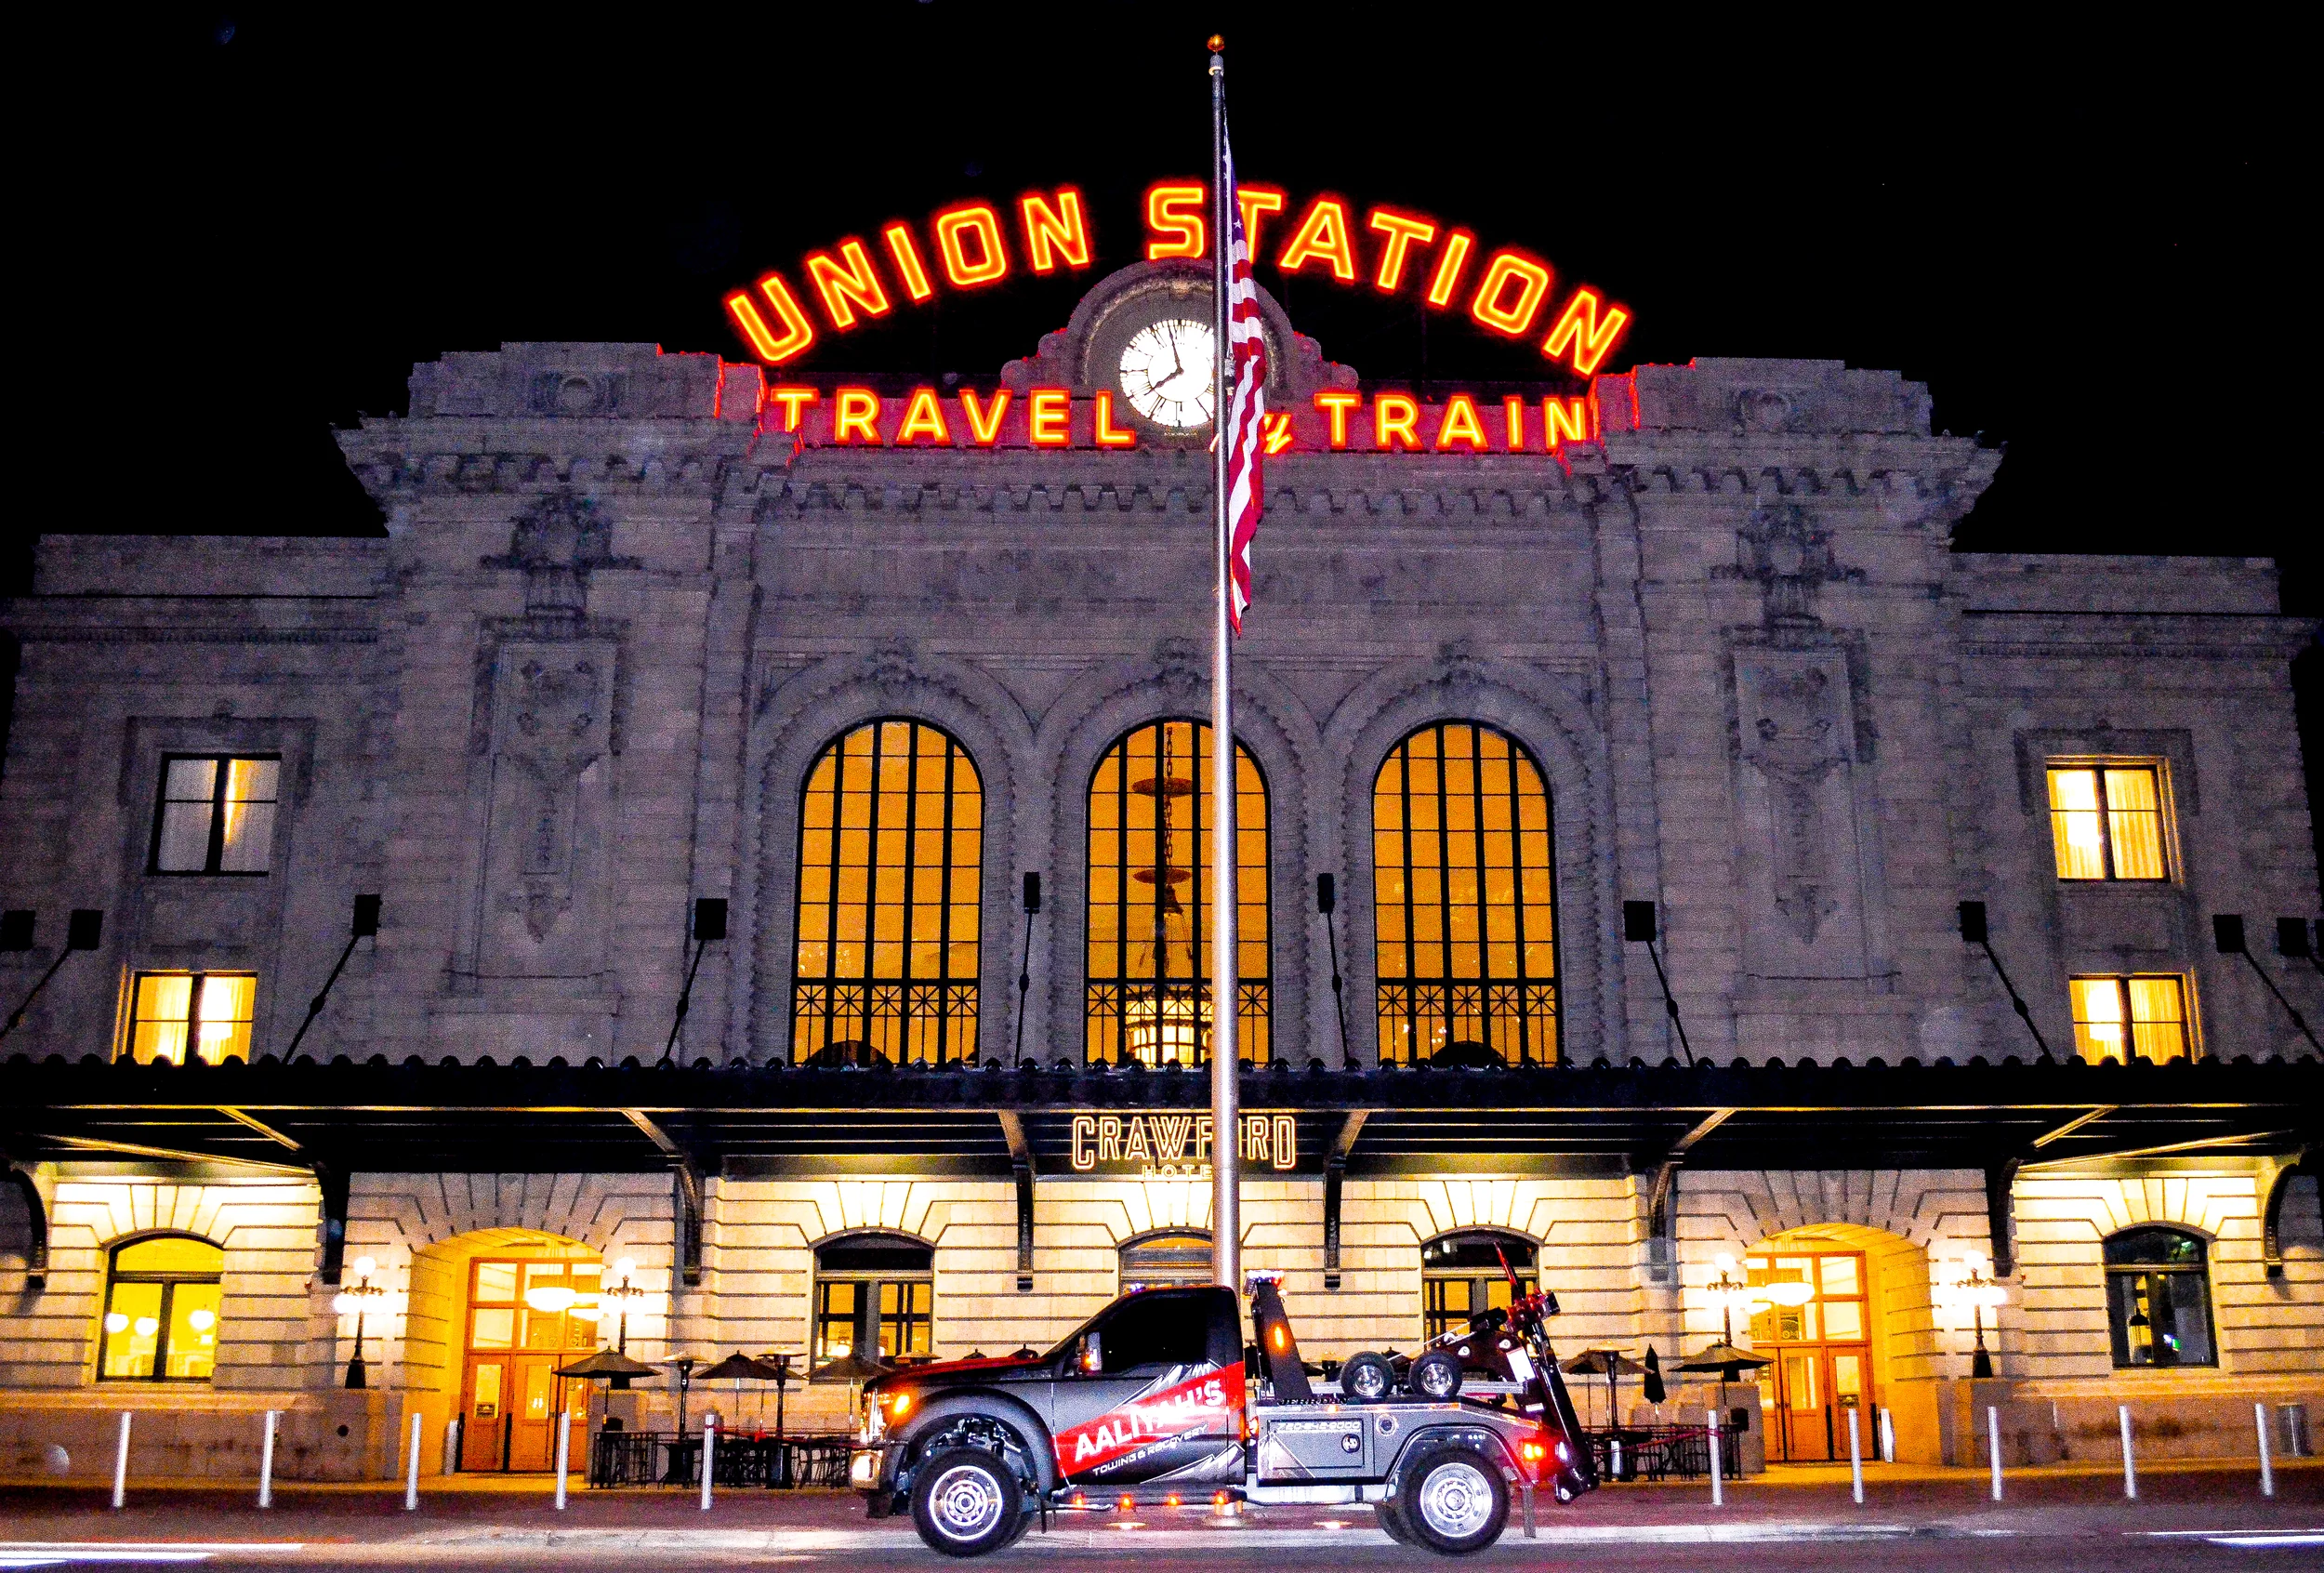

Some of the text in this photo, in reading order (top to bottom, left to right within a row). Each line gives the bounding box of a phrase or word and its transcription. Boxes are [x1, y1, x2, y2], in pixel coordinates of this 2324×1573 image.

[729, 187, 1628, 376] UNION STATION
[771, 389, 1136, 448] TRAVEL
[1314, 392, 1587, 452] TRAIN
[1072, 1116, 1297, 1170] CRAWFRD
[1142, 1164, 1212, 1179] HOTE
[1075, 1379, 1224, 1462] AALIYAH'S
[1092, 1423, 1208, 1476] TOWING & RECOVERY
